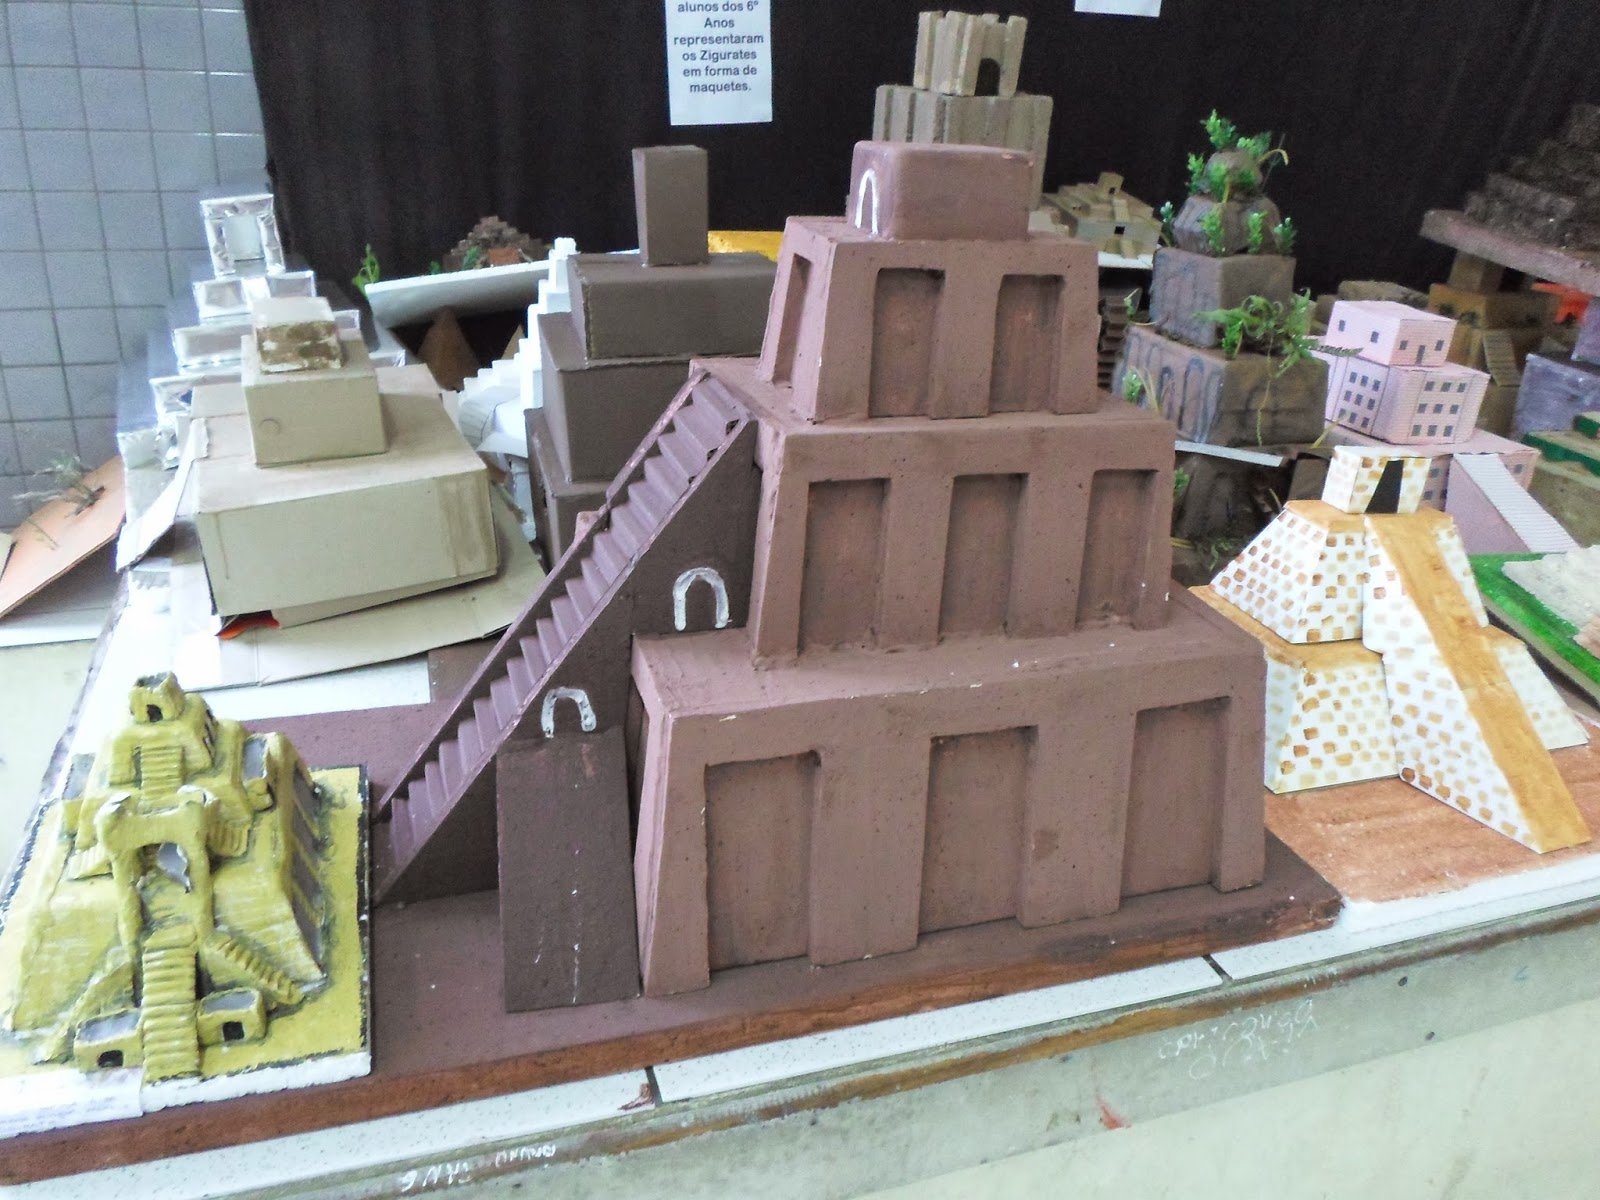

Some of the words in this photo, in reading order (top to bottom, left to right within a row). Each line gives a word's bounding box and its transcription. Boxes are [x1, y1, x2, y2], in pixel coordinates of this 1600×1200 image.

[677, 1, 719, 13] alunos
[722, 1, 744, 12] dos
[703, 17, 735, 28] Anos
[673, 33, 764, 47] representaram
[682, 52, 697, 61] os
[700, 50, 757, 63] Zigurates
[683, 68, 702, 77] em
[705, 66, 740, 76] forma
[742, 64, 758, 75] de
[689, 82, 752, 94] maquetes.
